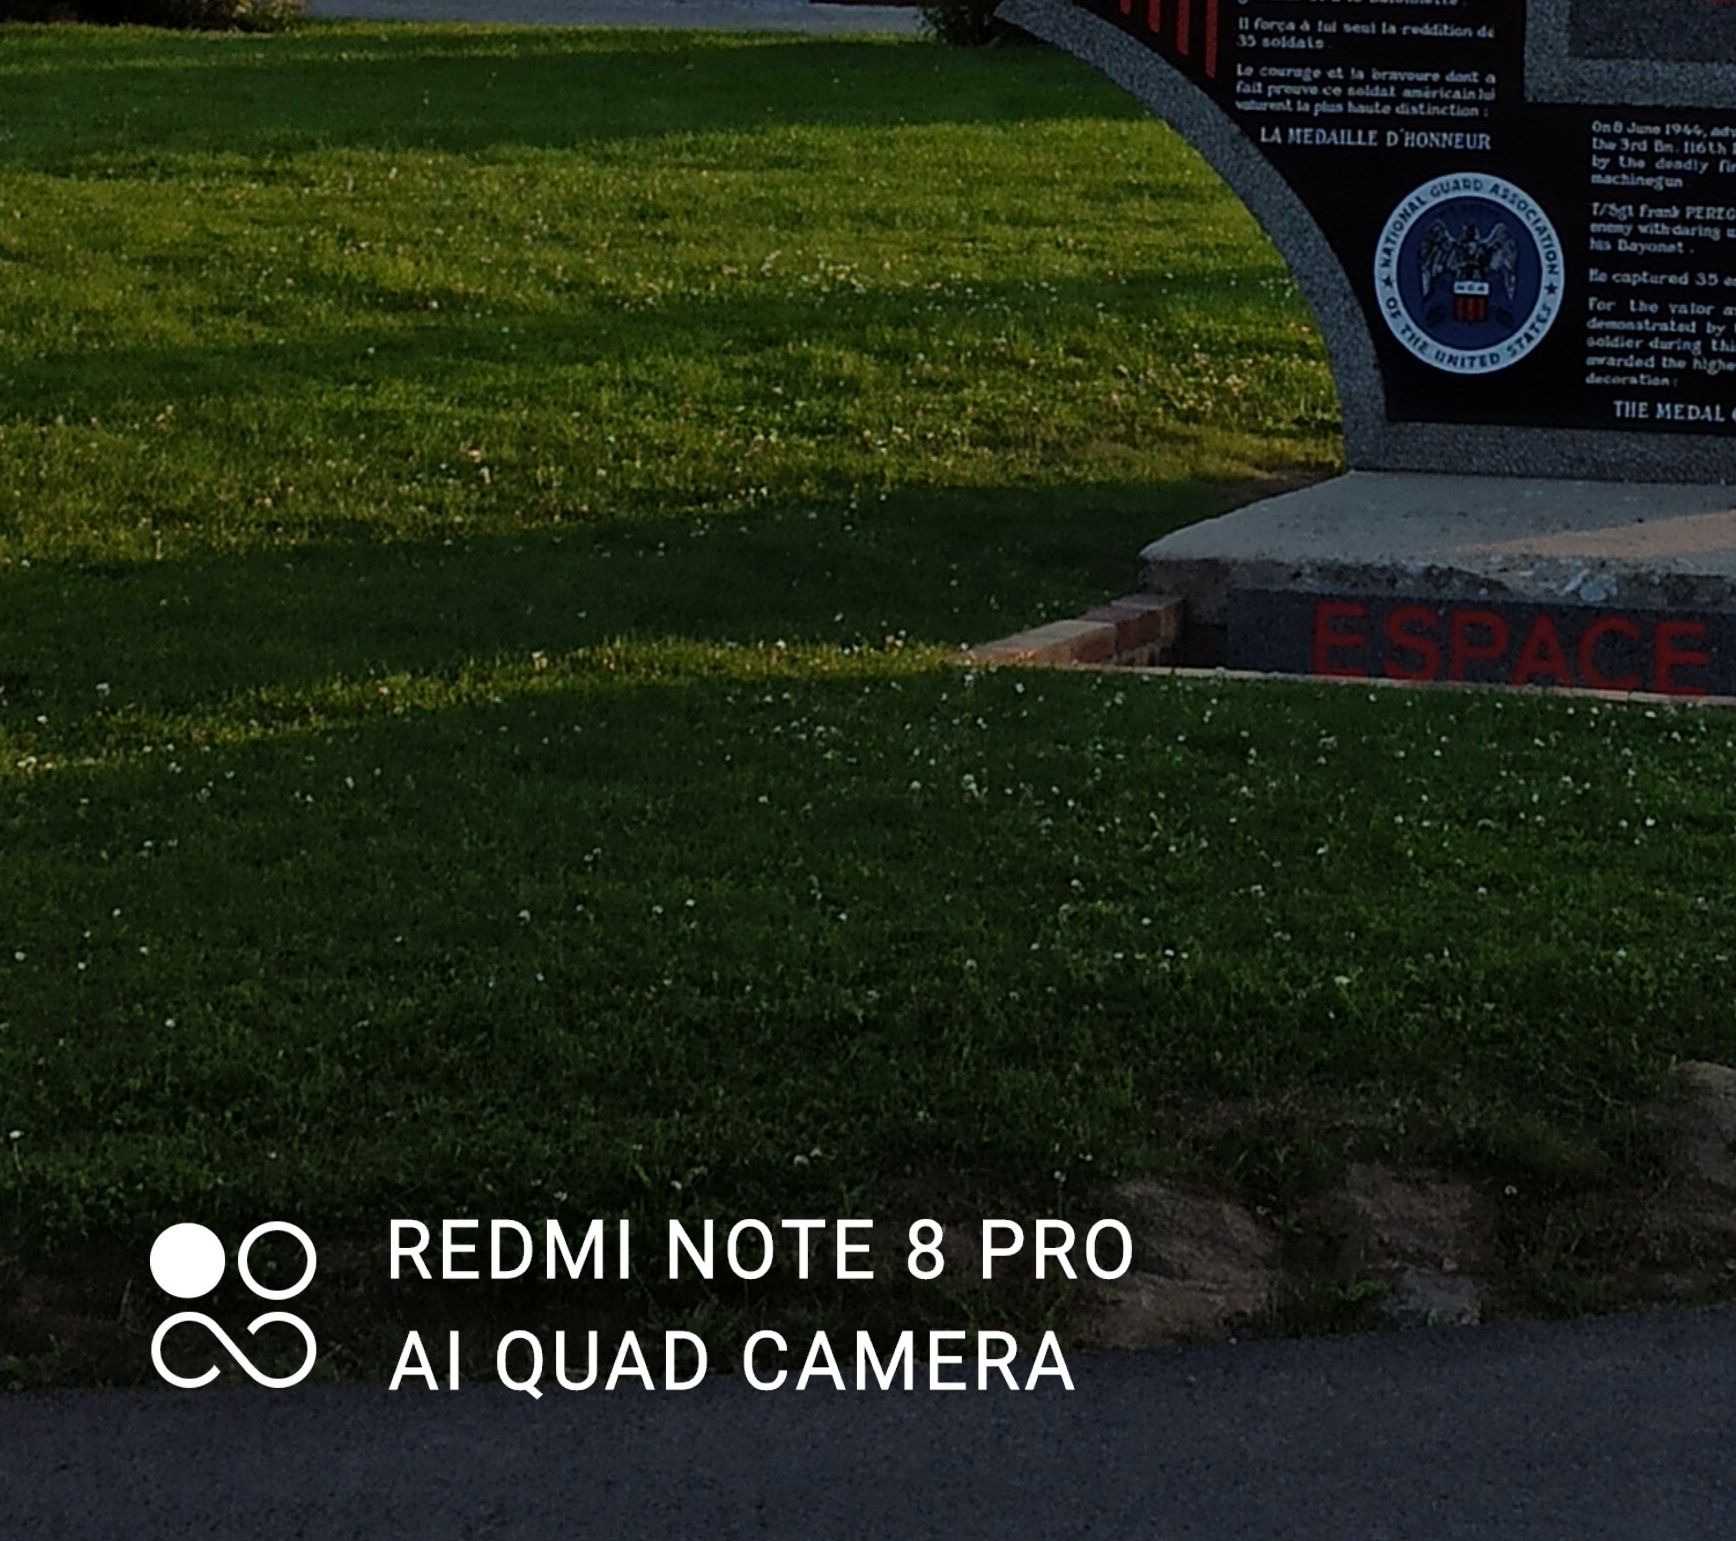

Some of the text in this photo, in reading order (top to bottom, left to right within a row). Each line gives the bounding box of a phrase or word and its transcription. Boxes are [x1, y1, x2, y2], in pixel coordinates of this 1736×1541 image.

[1317, 20, 1337, 33] lui
[1343, 22, 1376, 34] seul
[1381, 21, 1397, 35] la
[1401, 23, 1473, 38] reddition
[1239, 34, 1257, 47] 35
[1236, 63, 1254, 77] Le
[1259, 66, 1322, 82] courage
[1326, 66, 1344, 80] et
[1350, 67, 1365, 80] la
[1371, 68, 1441, 82] bravoure
[1445, 70, 1479, 83] dont
[1235, 80, 1263, 94] fait
[1267, 84, 1319, 98] preuve
[1322, 86, 1343, 96] ce
[1347, 84, 1396, 98] soldat
[1478, 88, 1496, 101] lui
[1235, 98, 1293, 112] valurent
[1296, 99, 1311, 112] la
[1313, 100, 1344, 117] plus
[1347, 102, 1392, 115] haute
[1591, 120, 1612, 134] On
[1626, 122, 1662, 135] June
[1260, 126, 1491, 150] LA MEDAILLE D'HONNEUR
[1592, 137, 1617, 151] the
[1620, 138, 1648, 152] 3rd
[1591, 154, 1611, 170] by
[1618, 154, 1646, 169] the
[1654, 157, 1709, 175] deadly
[1381, 178, 1559, 275] NATIONAL GUARD ASSOCIATION
[1589, 222, 1633, 237] enemy
[1637, 222, 1670, 236] with
[1671, 224, 1721, 242] daring
[1589, 237, 1612, 251] his
[1588, 268, 1608, 283] He
[1611, 270, 1689, 287] captured
[1695, 272, 1719, 287] 35
[1588, 296, 1616, 311] For
[1629, 299, 1659, 314] the
[1668, 302, 1715, 316] valor
[1386, 297, 1551, 367] OF THE UNITED STATES
[1586, 316, 1697, 334] demonstrated
[1705, 321, 1726, 337] by
[1586, 336, 1644, 349] soldier
[1648, 336, 1702, 356] during
[1585, 354, 1655, 369] awarded
[1661, 356, 1687, 369] the
[1613, 400, 1649, 419] THE
[1656, 402, 1725, 422] MEDAL
[1314, 603, 1708, 698] ESPACE
